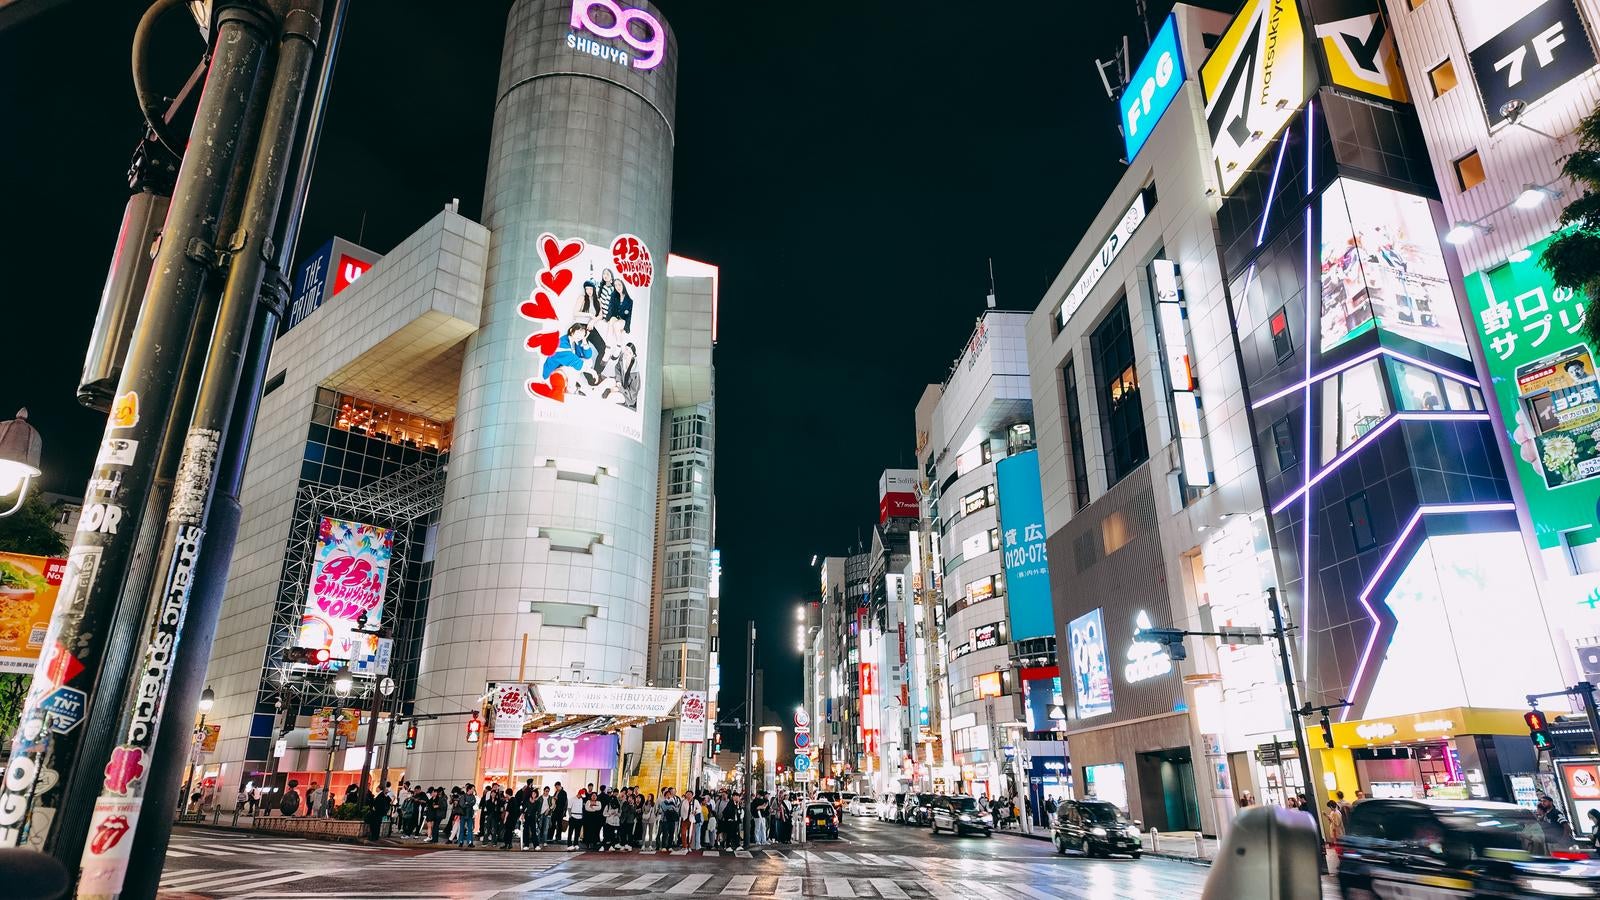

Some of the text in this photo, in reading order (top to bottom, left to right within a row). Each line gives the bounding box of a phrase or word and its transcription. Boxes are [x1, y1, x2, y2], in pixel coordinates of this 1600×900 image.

[567, 34, 628, 66] SHIBUYA
[571, 0, 664, 69] 109
[1494, 21, 1566, 88] 7F
[1128, 51, 1174, 137] FPG
[613, 237, 650, 261] 45th
[303, 255, 323, 293] THE
[623, 273, 650, 288] LOVE
[289, 281, 323, 329] PRIME
[1480, 286, 1574, 335] 野口の
[322, 556, 381, 592] 45th
[54, 696, 80, 712] TNT
[538, 737, 578, 768] 109
